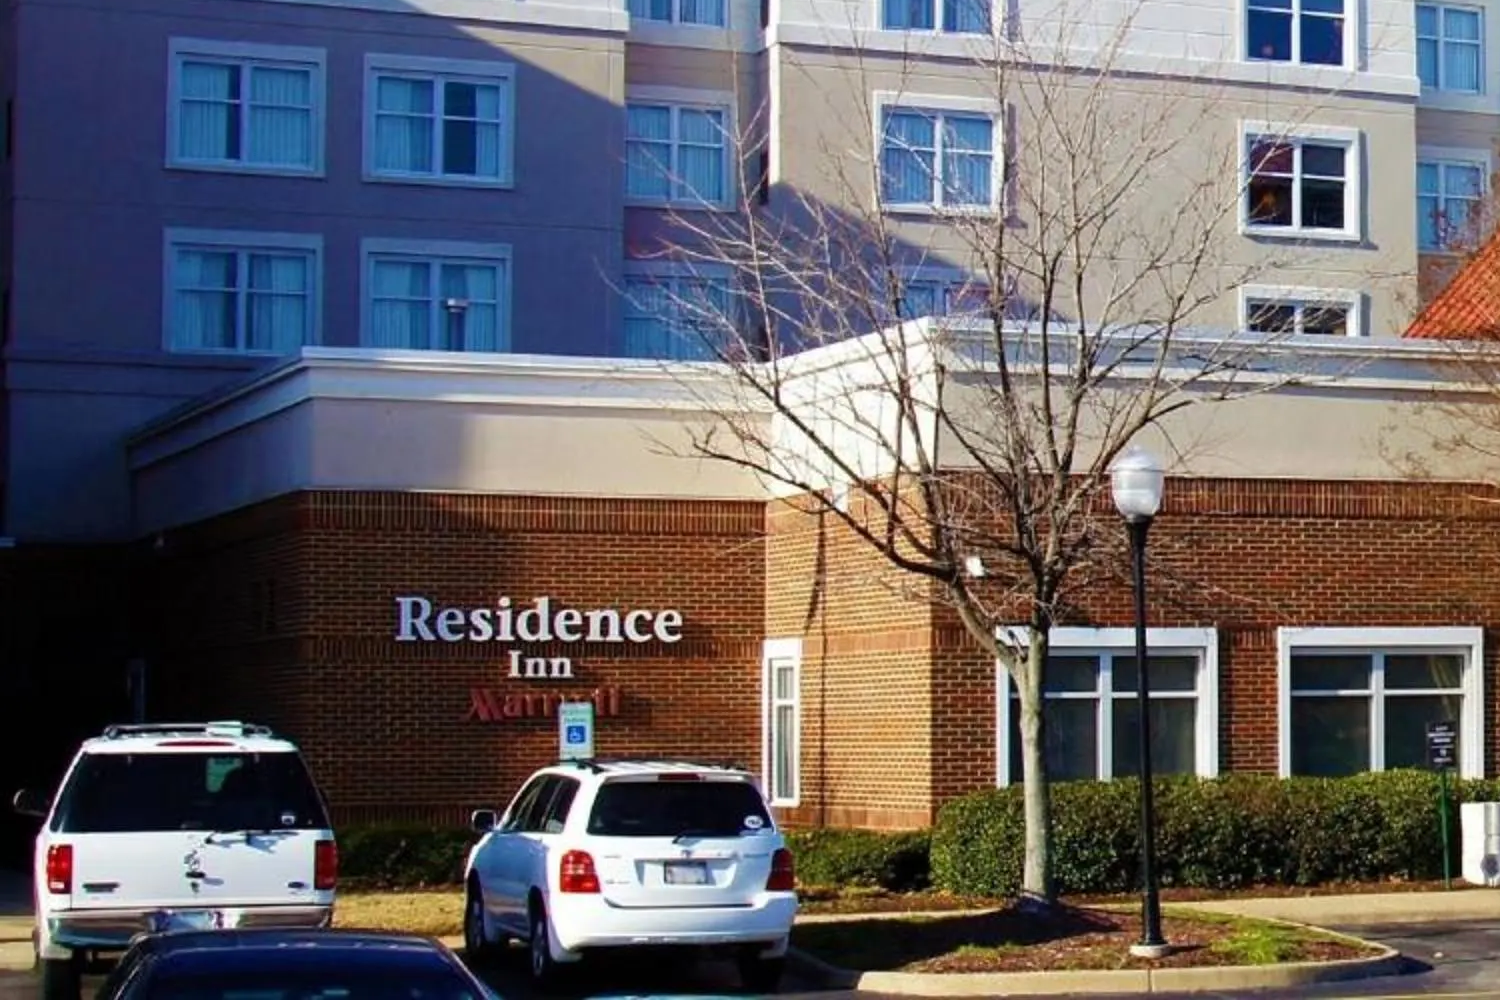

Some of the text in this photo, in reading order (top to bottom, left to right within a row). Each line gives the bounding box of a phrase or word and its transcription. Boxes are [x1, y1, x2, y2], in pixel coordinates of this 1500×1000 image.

[396, 597, 683, 642] Residence
[508, 651, 573, 678] Inn
[465, 686, 621, 721] Marrtt
